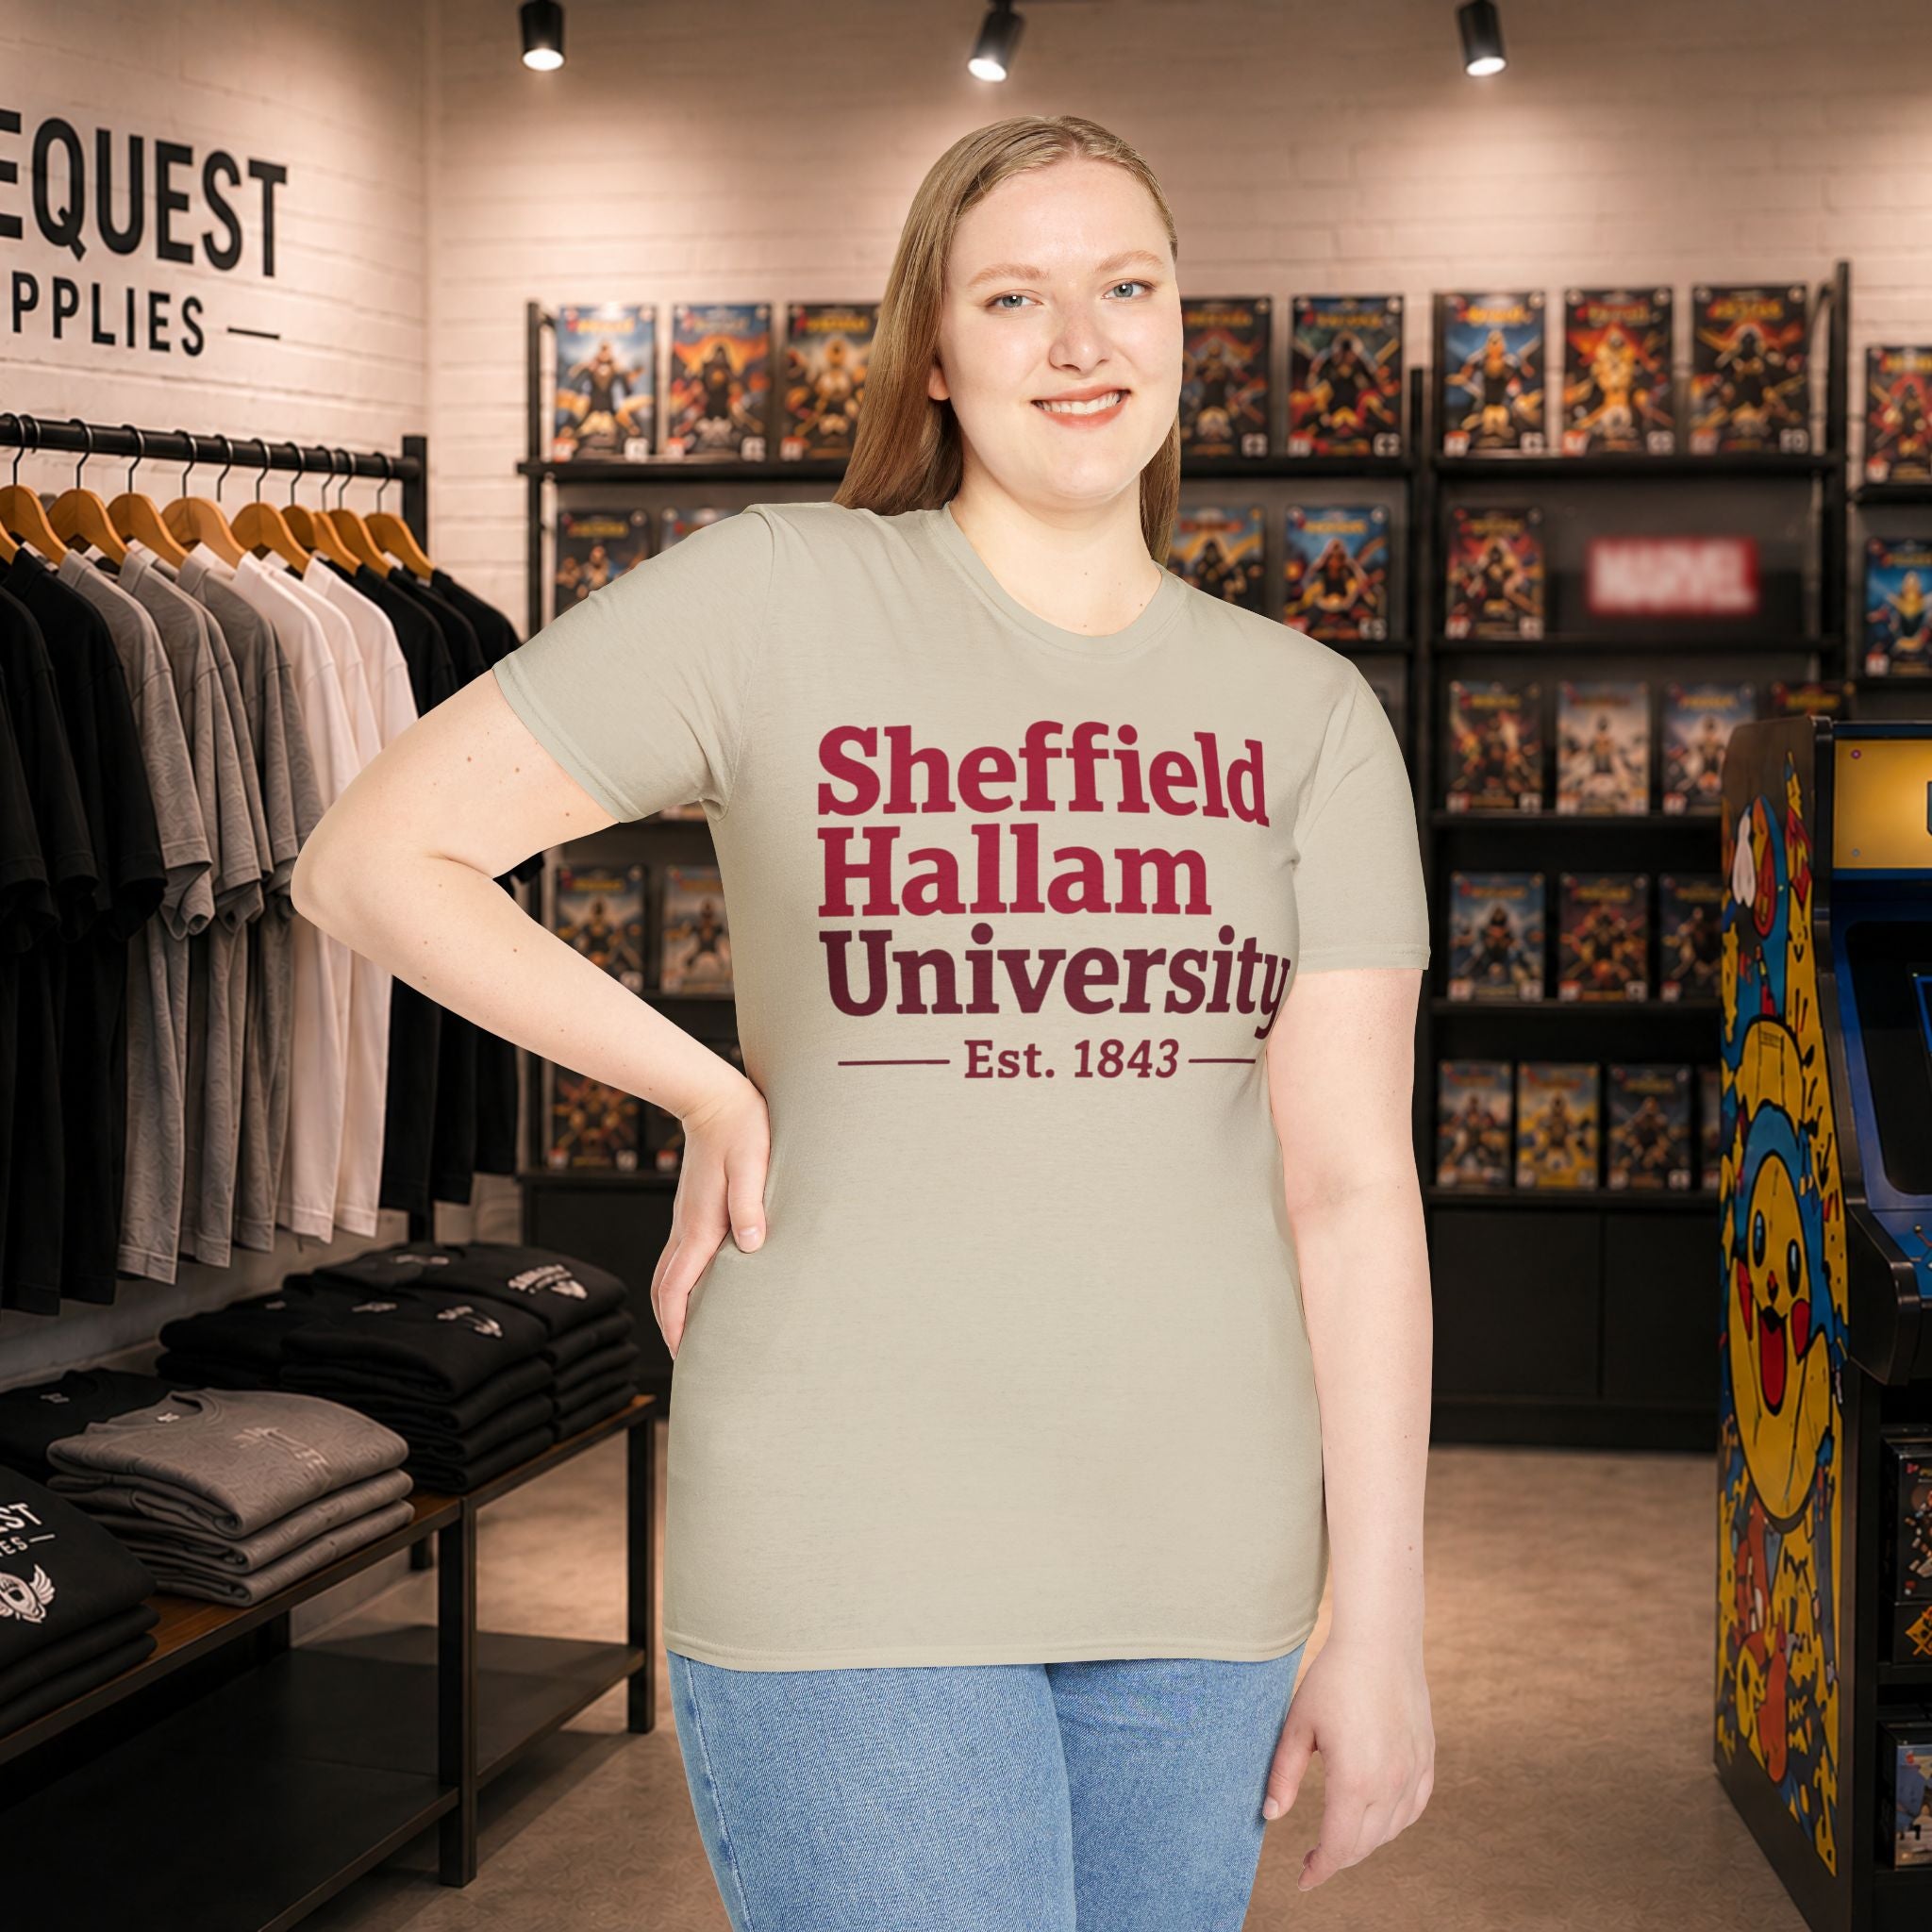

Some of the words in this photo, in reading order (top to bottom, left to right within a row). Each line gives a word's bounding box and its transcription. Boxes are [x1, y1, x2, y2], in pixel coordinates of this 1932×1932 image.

[11, 271, 205, 357] PPLIES
[818, 720, 1270, 828] Sheffield
[817, 823, 1212, 917] Hallam
[818, 922, 1291, 1040] University
[964, 1040, 1055, 1079] Est.
[1074, 1039, 1179, 1079] 1843
[0, 1503, 42, 1533] ST
